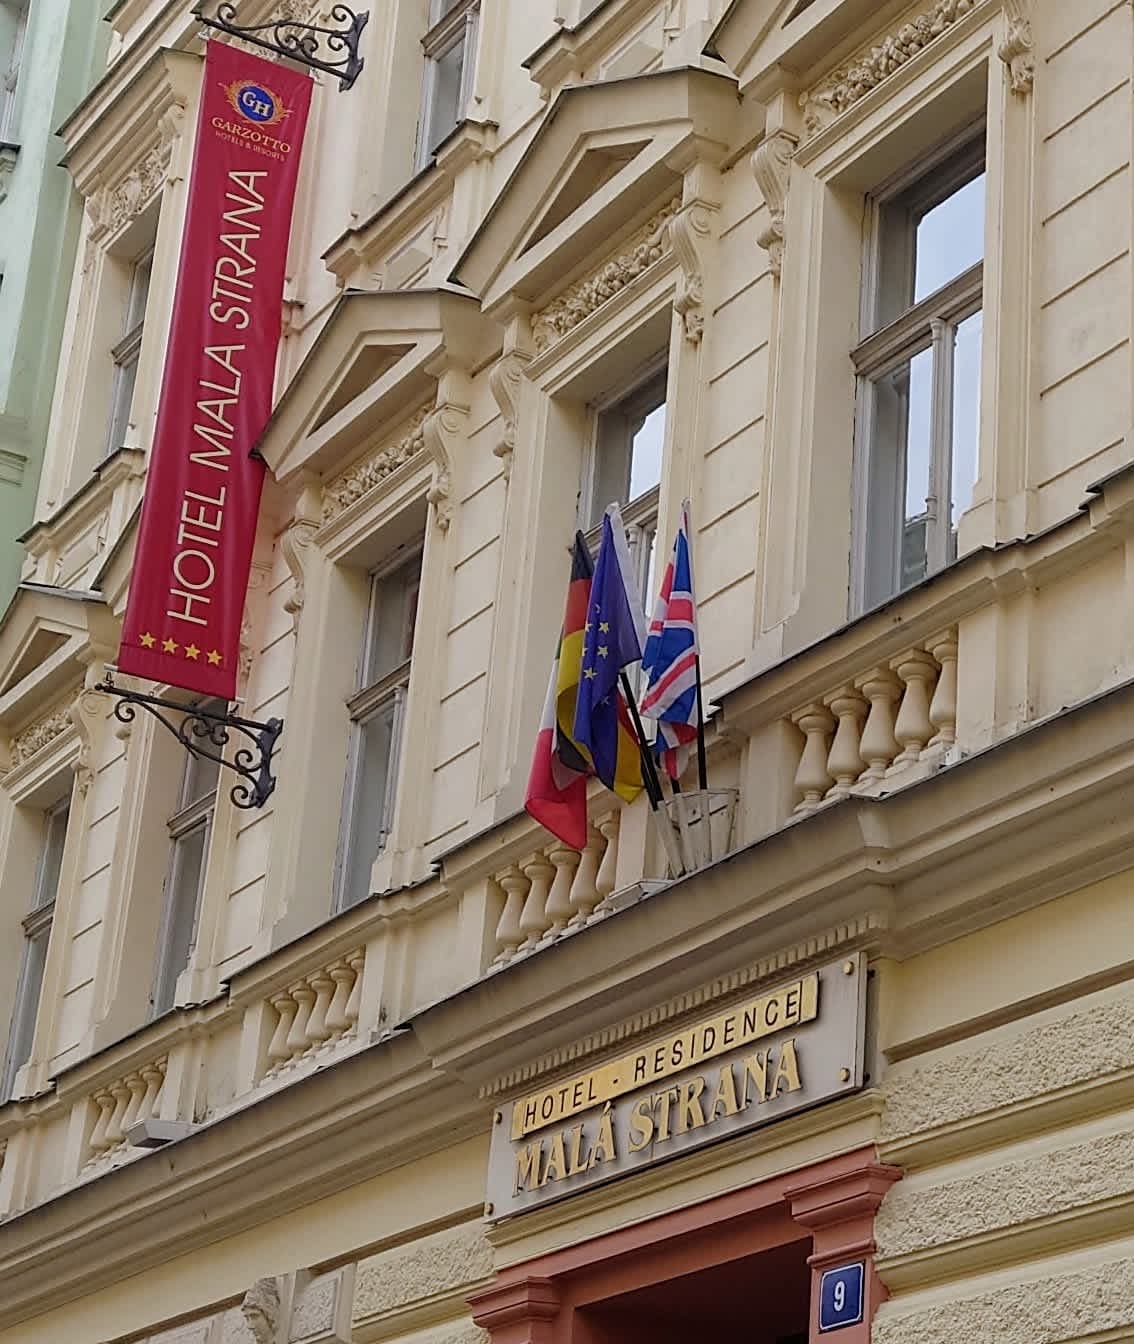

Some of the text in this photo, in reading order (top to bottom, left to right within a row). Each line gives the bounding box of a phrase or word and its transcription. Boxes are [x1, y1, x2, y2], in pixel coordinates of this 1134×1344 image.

[212, 117, 291, 152] GARZOTTO
[166, 170, 268, 625] HOTEL MALA STRANA
[511, 1038, 803, 1197] MALÁ STRANA
[524, 1077, 598, 1127] HOTEL
[633, 989, 799, 1083] RESIDENCE
[833, 1280, 846, 1312] 9
